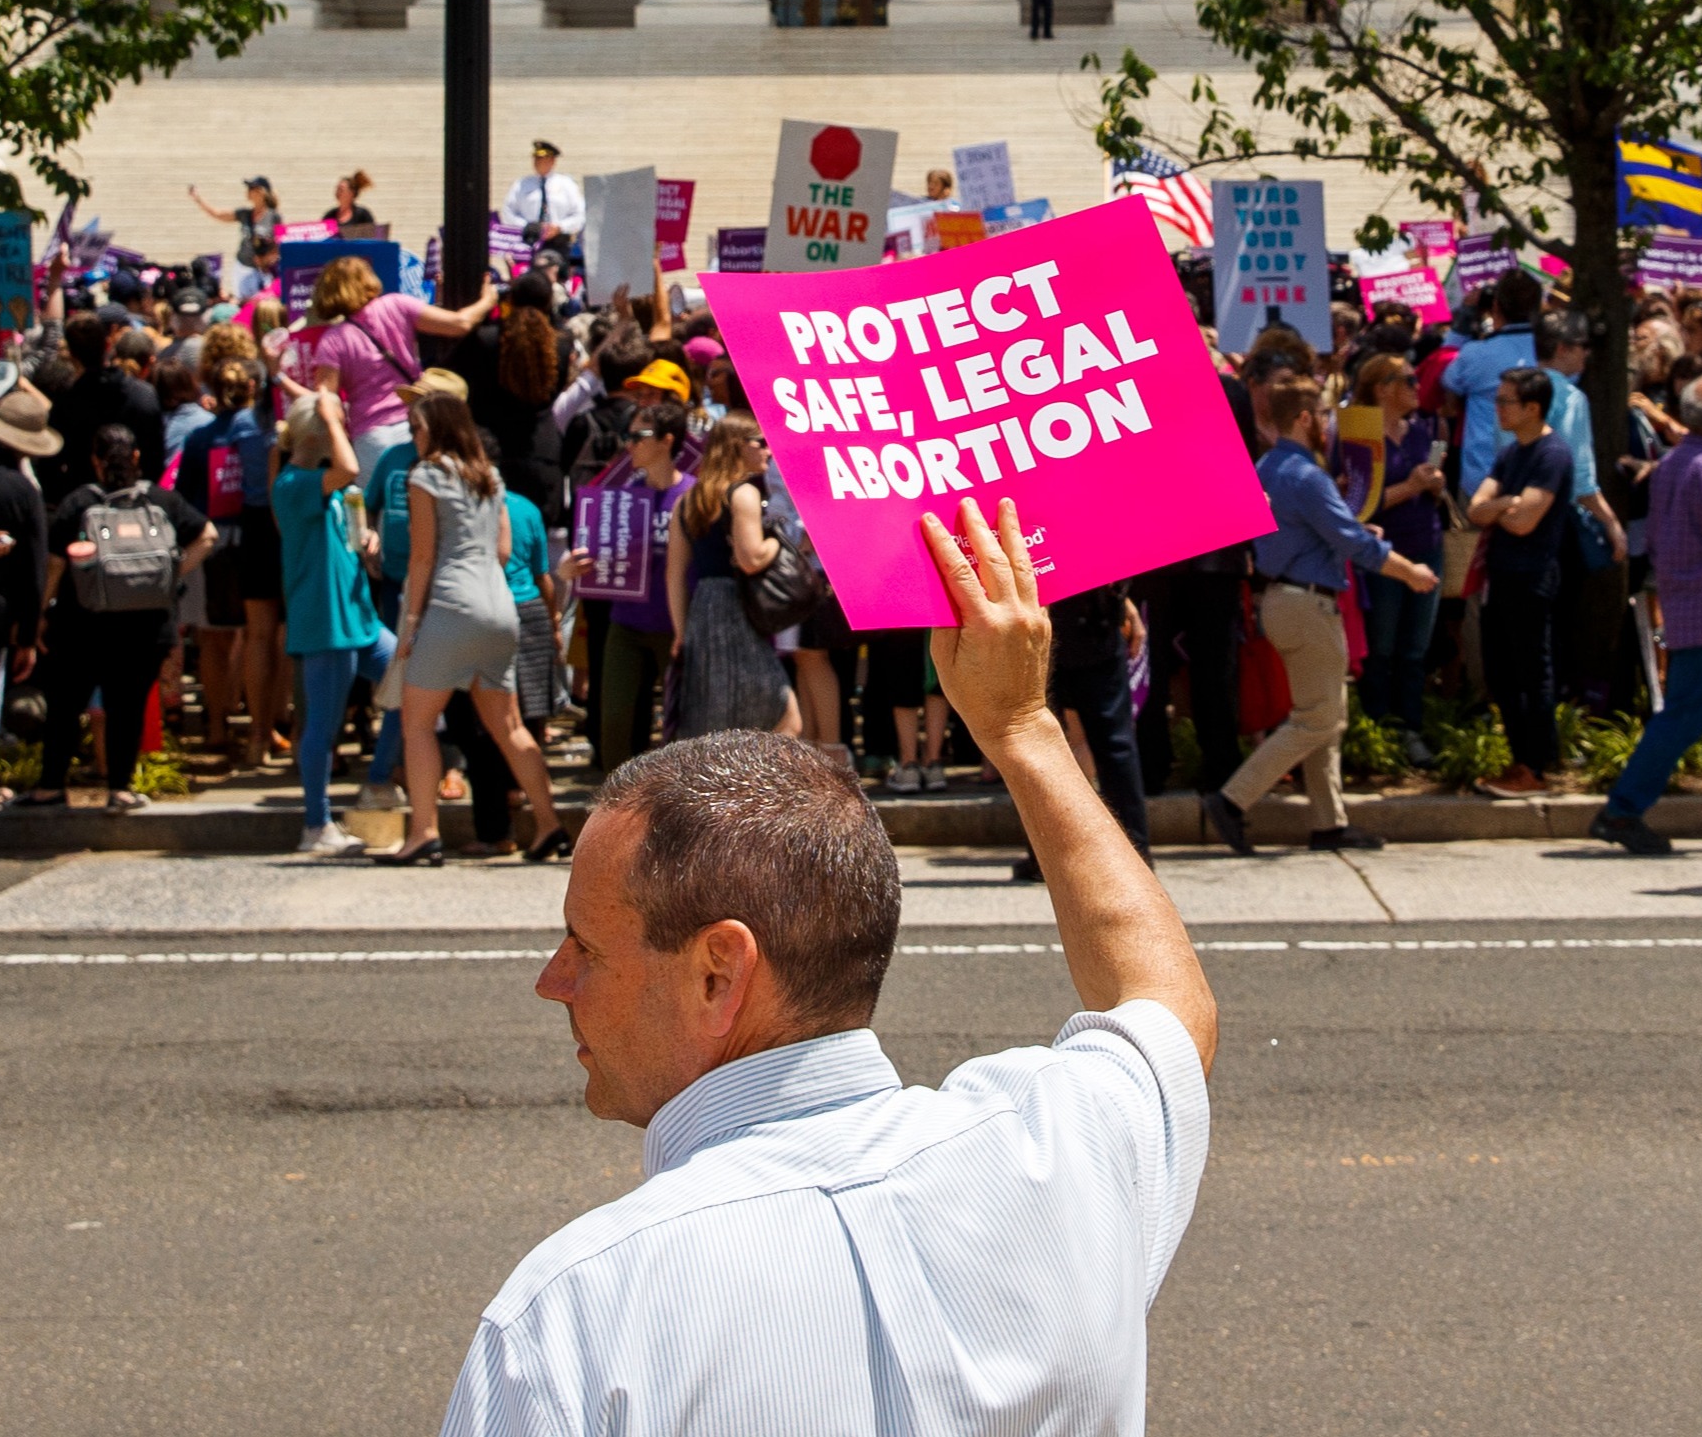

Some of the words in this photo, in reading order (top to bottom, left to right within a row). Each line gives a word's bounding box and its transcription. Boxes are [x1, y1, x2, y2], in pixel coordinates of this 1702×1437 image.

[808, 183, 854, 207] THE
[1235, 208, 1301, 226] YOUR
[786, 204, 869, 243] WAR
[806, 241, 838, 262] ON
[1238, 253, 1307, 272] BODY
[779, 259, 1061, 365] PROTECT
[772, 376, 915, 437] SAFE,
[919, 309, 1159, 422] LEGAL
[823, 378, 1153, 500] ABORTION
[598, 490, 616, 544] Human
[615, 490, 635, 559] Abortion
